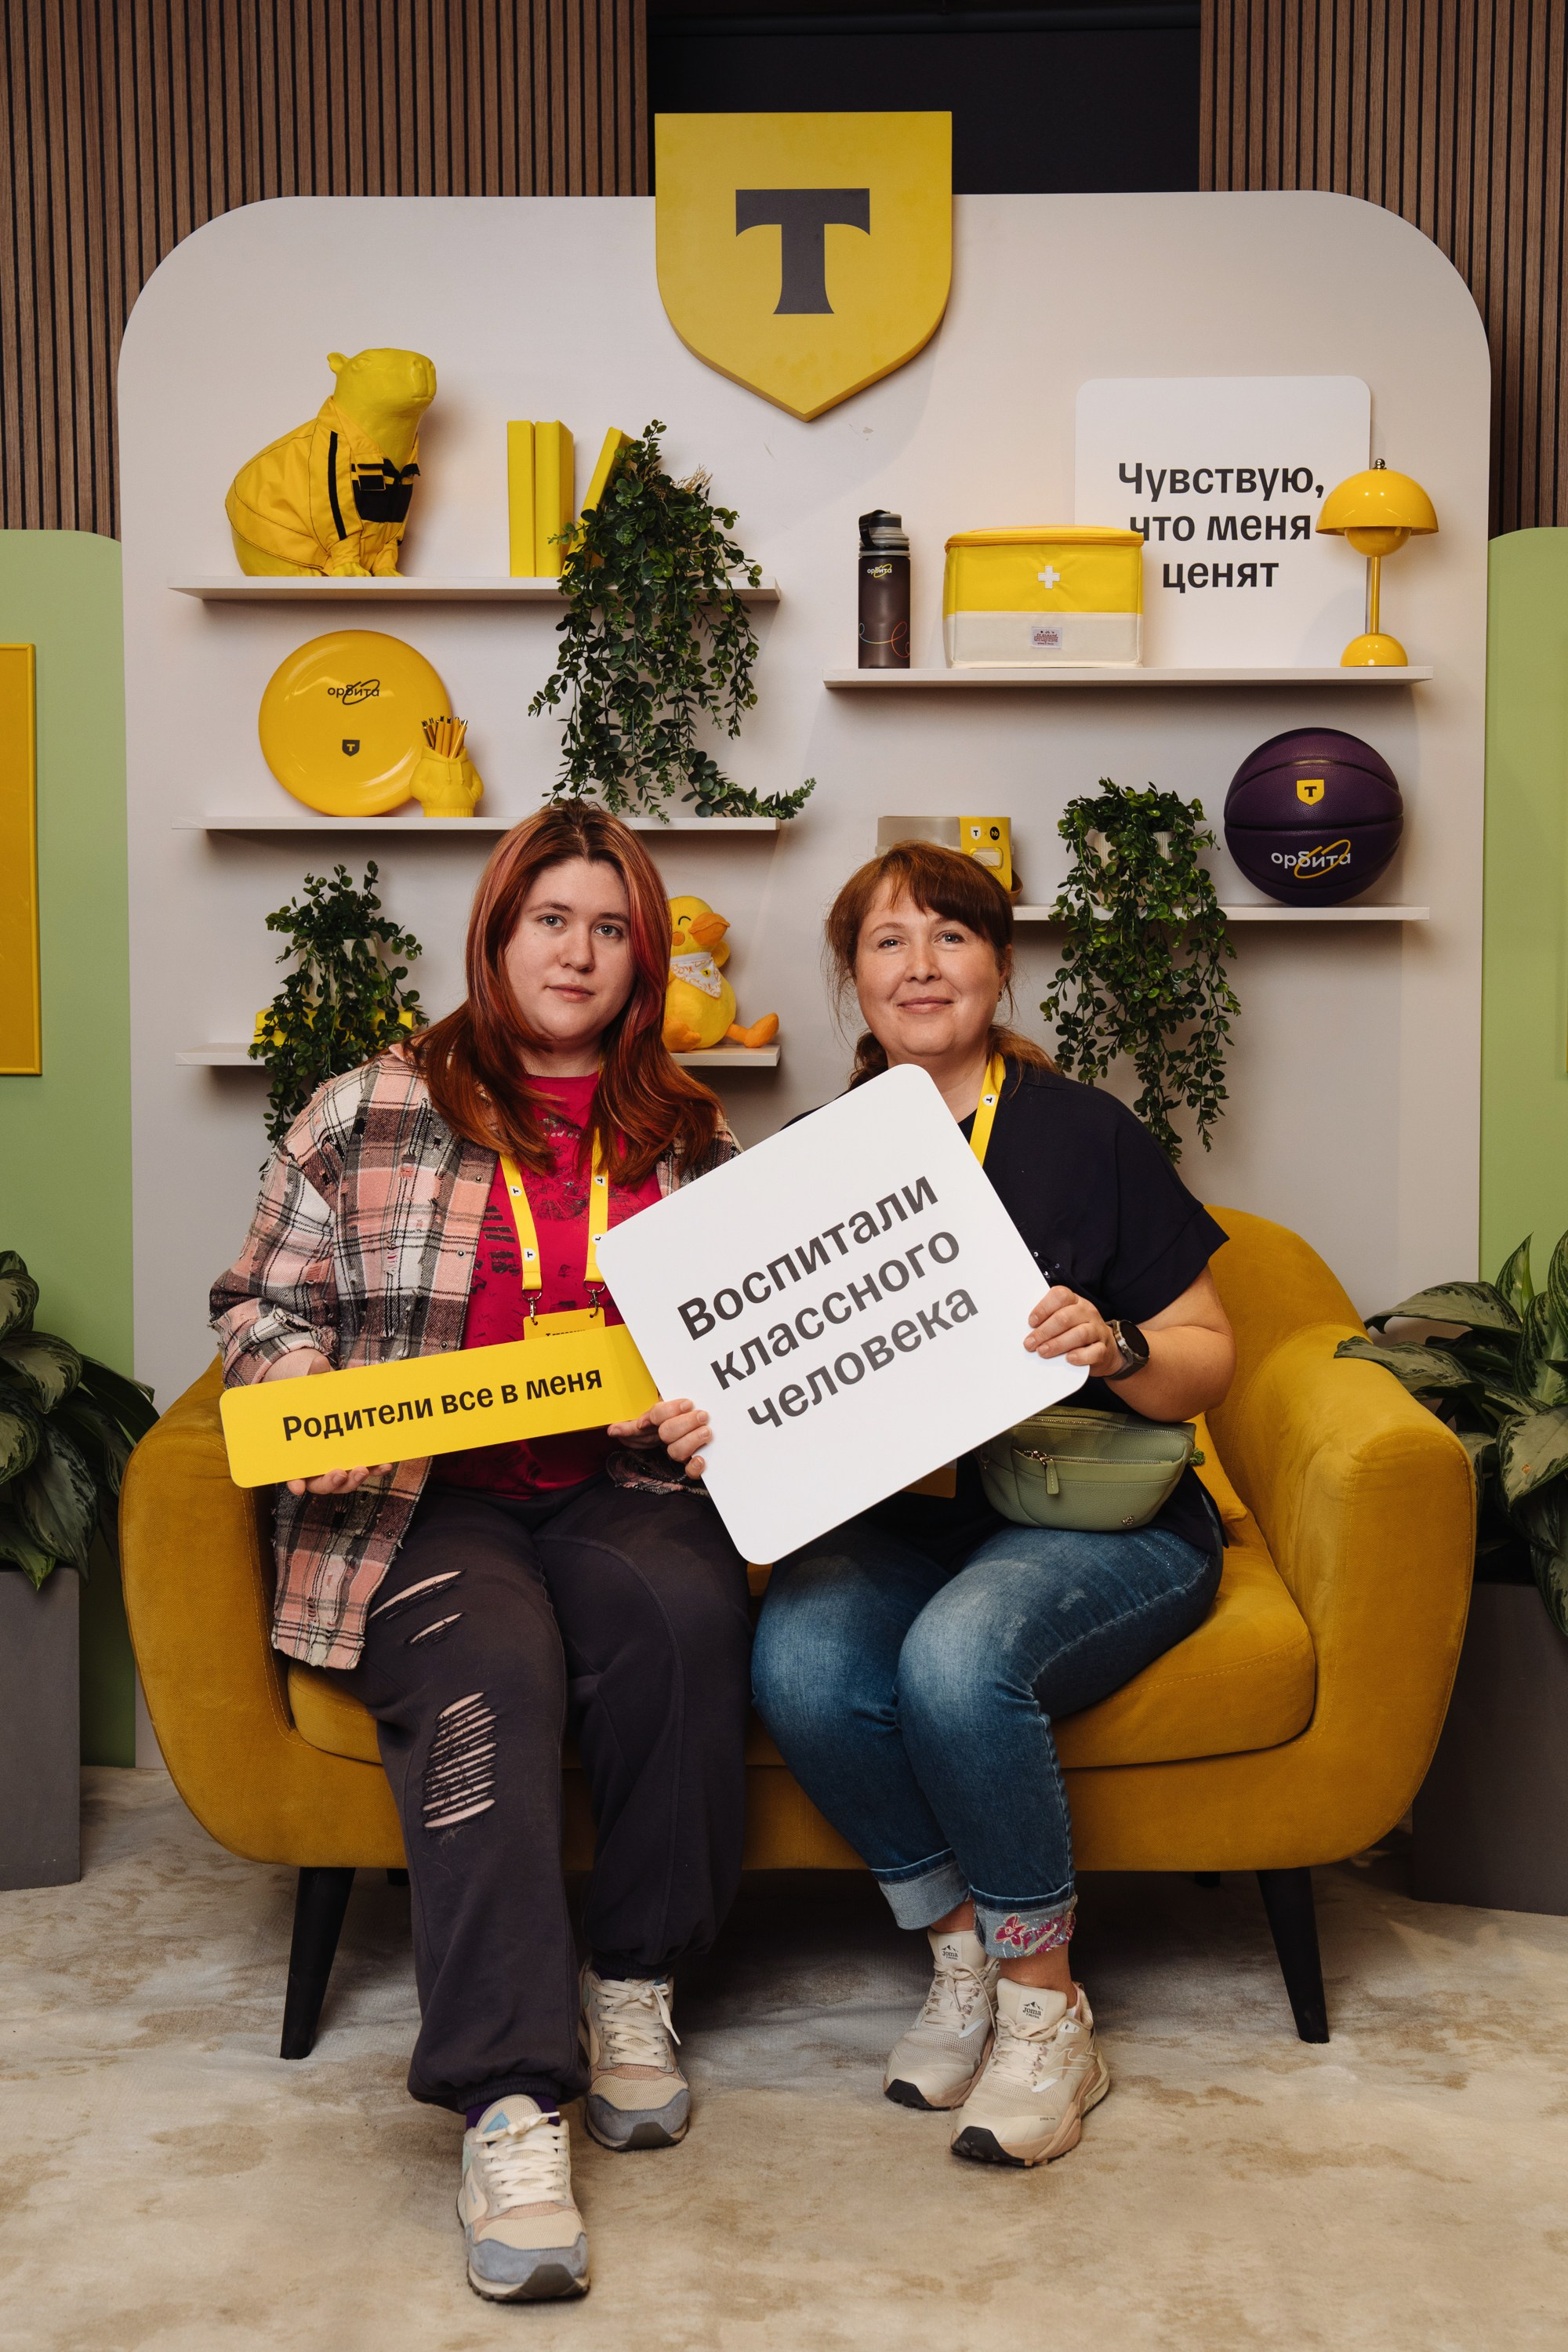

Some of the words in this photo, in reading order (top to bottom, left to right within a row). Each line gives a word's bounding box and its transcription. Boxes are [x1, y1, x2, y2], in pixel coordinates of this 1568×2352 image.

[1118, 462, 1324, 503] Чувствую,
[1130, 514, 1196, 542] что
[1207, 514, 1311, 541] меня
[866, 566, 892, 575] орбита
[1162, 561, 1279, 594] ценят
[327, 684, 380, 699] орбита
[1270, 850, 1352, 870] орбита
[677, 1175, 938, 1341] Воспитали
[710, 1231, 960, 1391] классного
[747, 1288, 979, 1428] человека
[282, 1397, 434, 1441] Родители
[441, 1386, 494, 1414] все
[500, 1383, 518, 1404] в
[526, 1369, 604, 1401] меня
